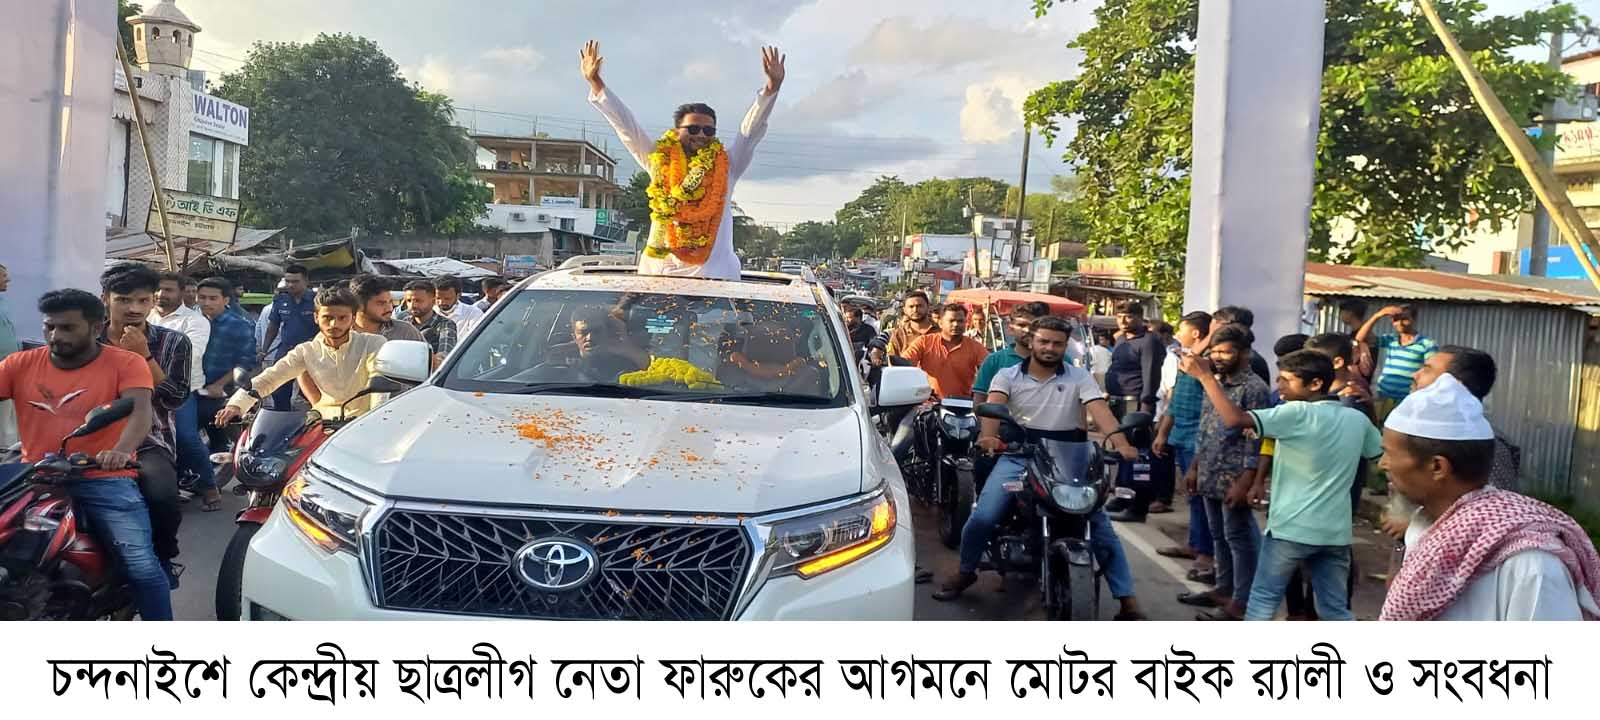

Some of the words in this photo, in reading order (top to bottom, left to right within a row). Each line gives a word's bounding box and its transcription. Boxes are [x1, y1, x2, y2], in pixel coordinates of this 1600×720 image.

[194, 94, 247, 129] WALTON
[177, 199, 201, 214] আই
[203, 199, 214, 214] ডি
[216, 206, 237, 218] এফ
